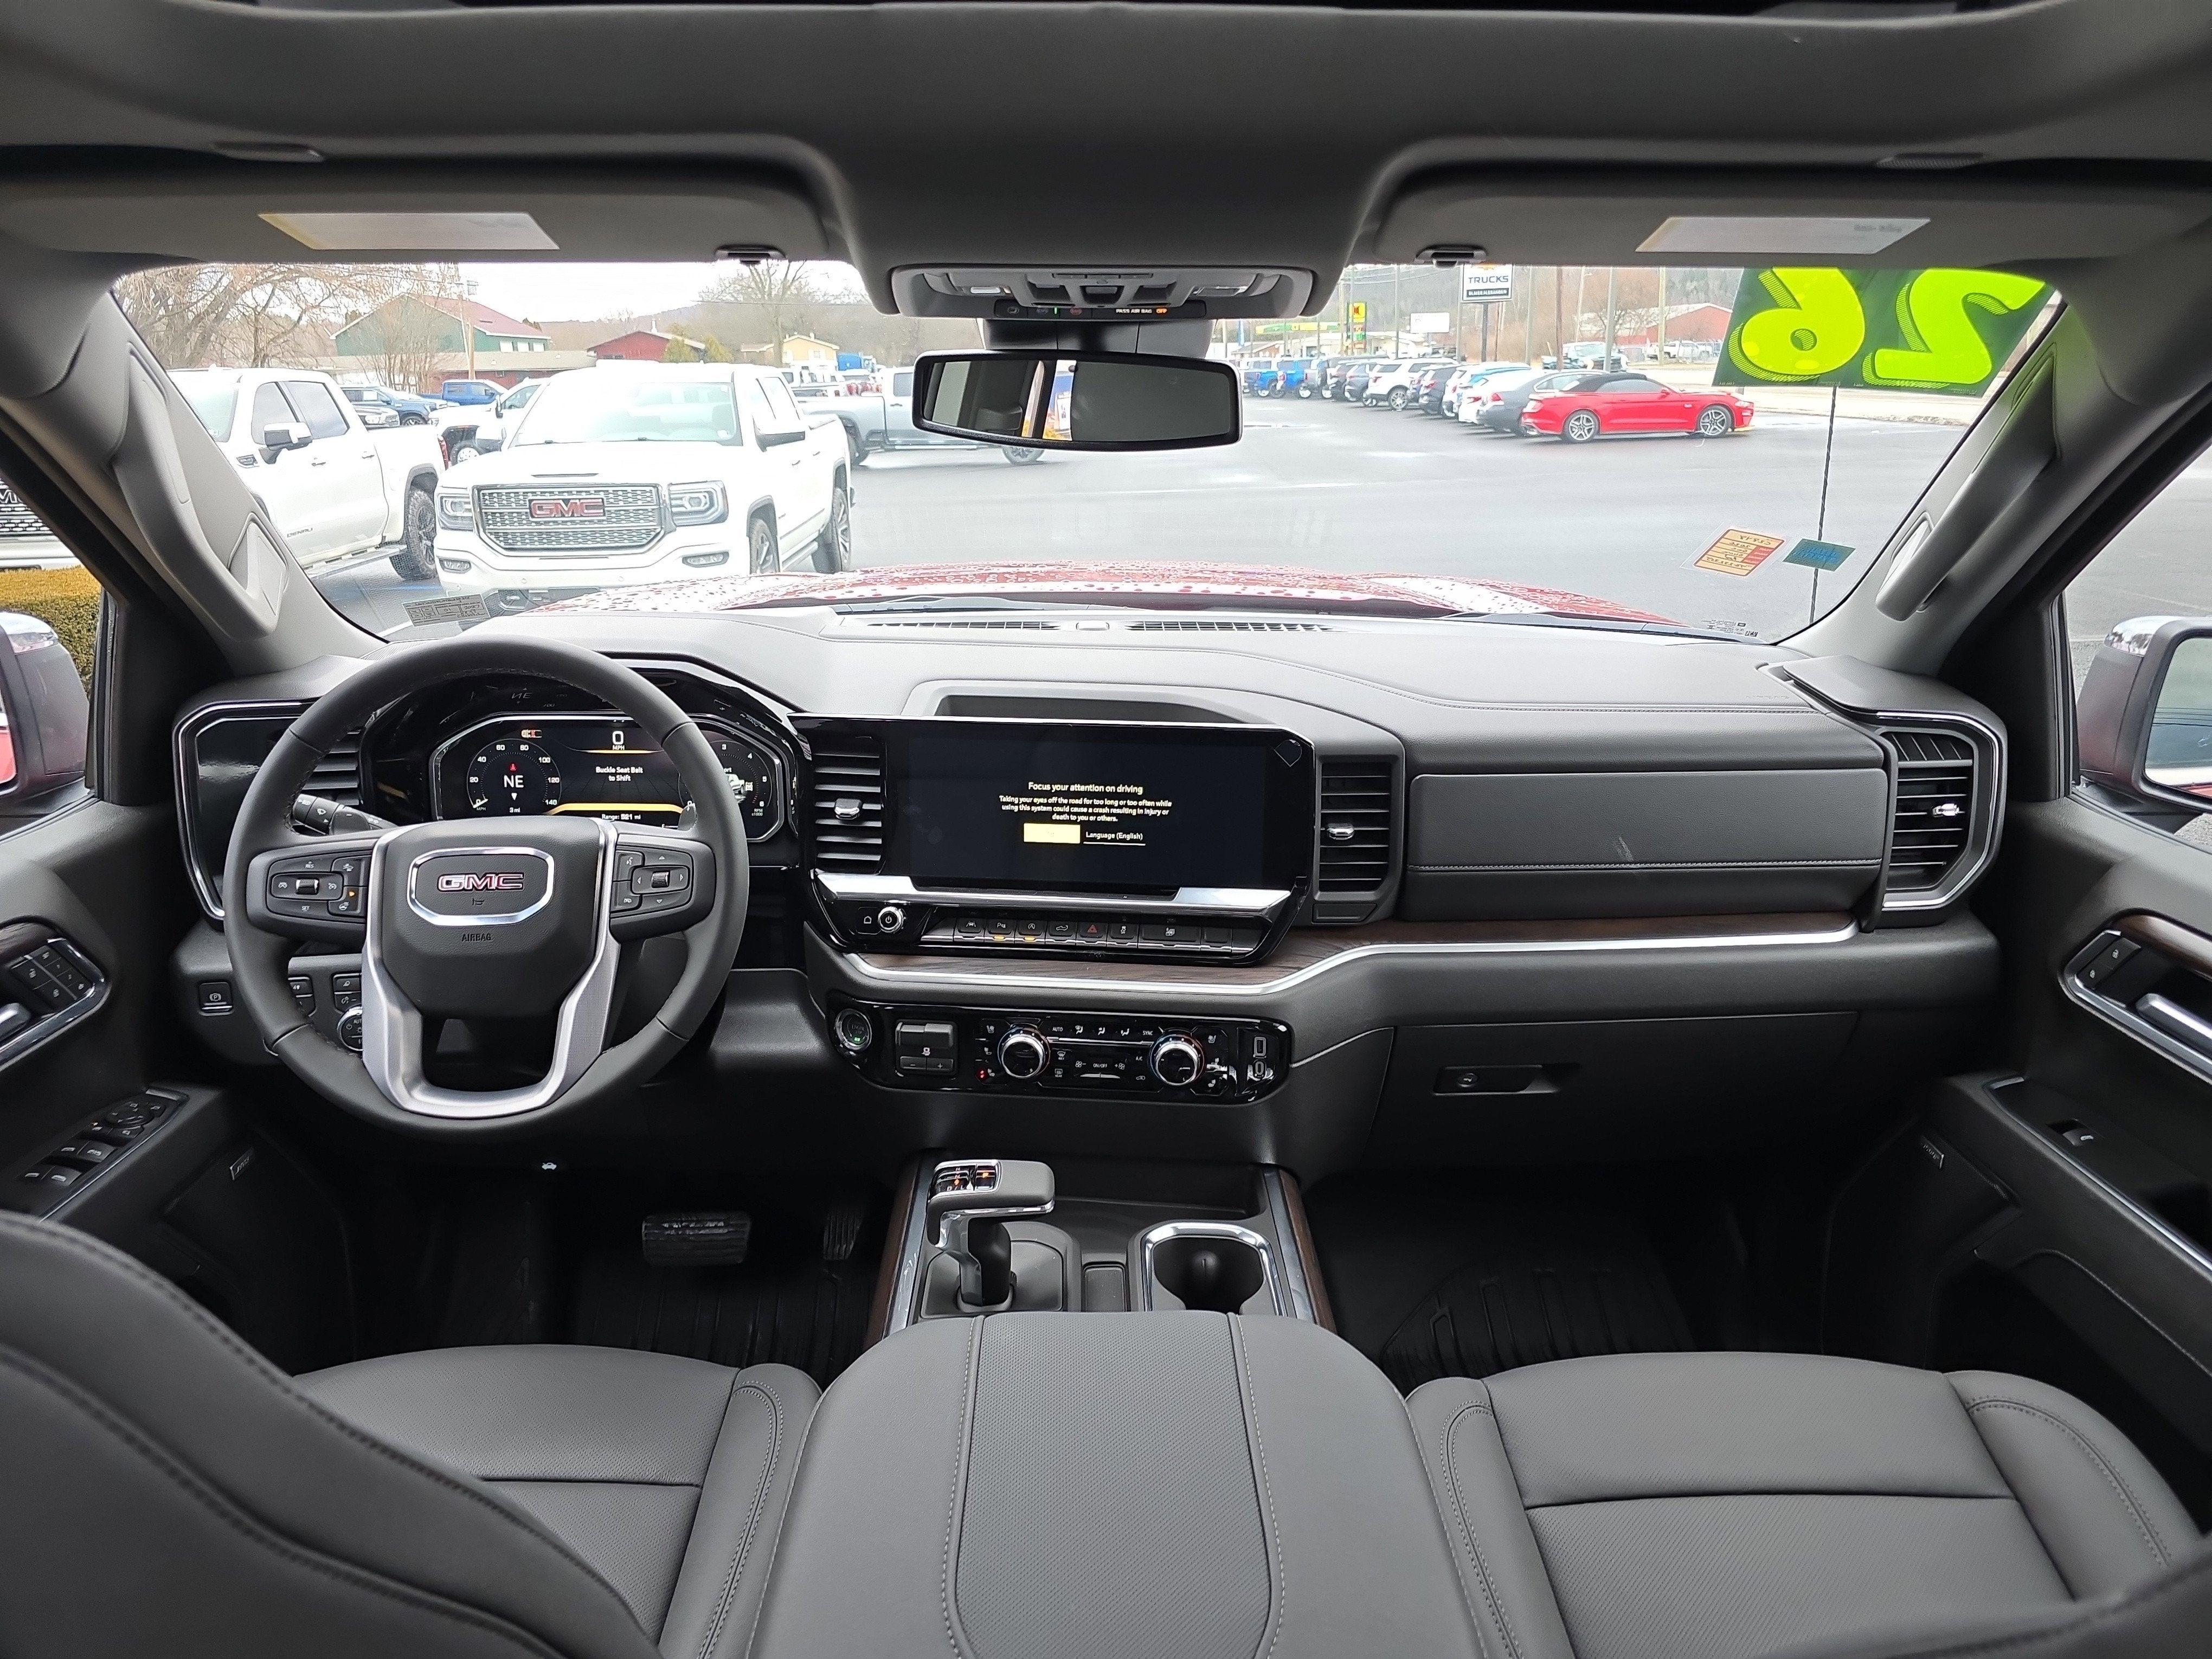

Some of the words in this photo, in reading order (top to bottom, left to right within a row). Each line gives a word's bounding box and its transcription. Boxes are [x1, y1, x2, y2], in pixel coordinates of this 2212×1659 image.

[1468, 275, 1509, 284] TRUCKS
[531, 498, 603, 518] GMC
[287, 528, 313, 538] DENALI
[613, 731, 623, 745] 0
[504, 775, 524, 788] NE
[1028, 782, 1051, 790] Focus
[1070, 784, 1104, 792] attention
[1117, 784, 1143, 795] driving
[999, 795, 1018, 803] Taking
[1110, 807, 1136, 815] resulting
[1144, 808, 1161, 816] injury
[1086, 831, 1115, 839] Language
[1116, 832, 1143, 840] (English)
[438, 873, 524, 892] GMC
[462, 933, 492, 942] AIRBAG
